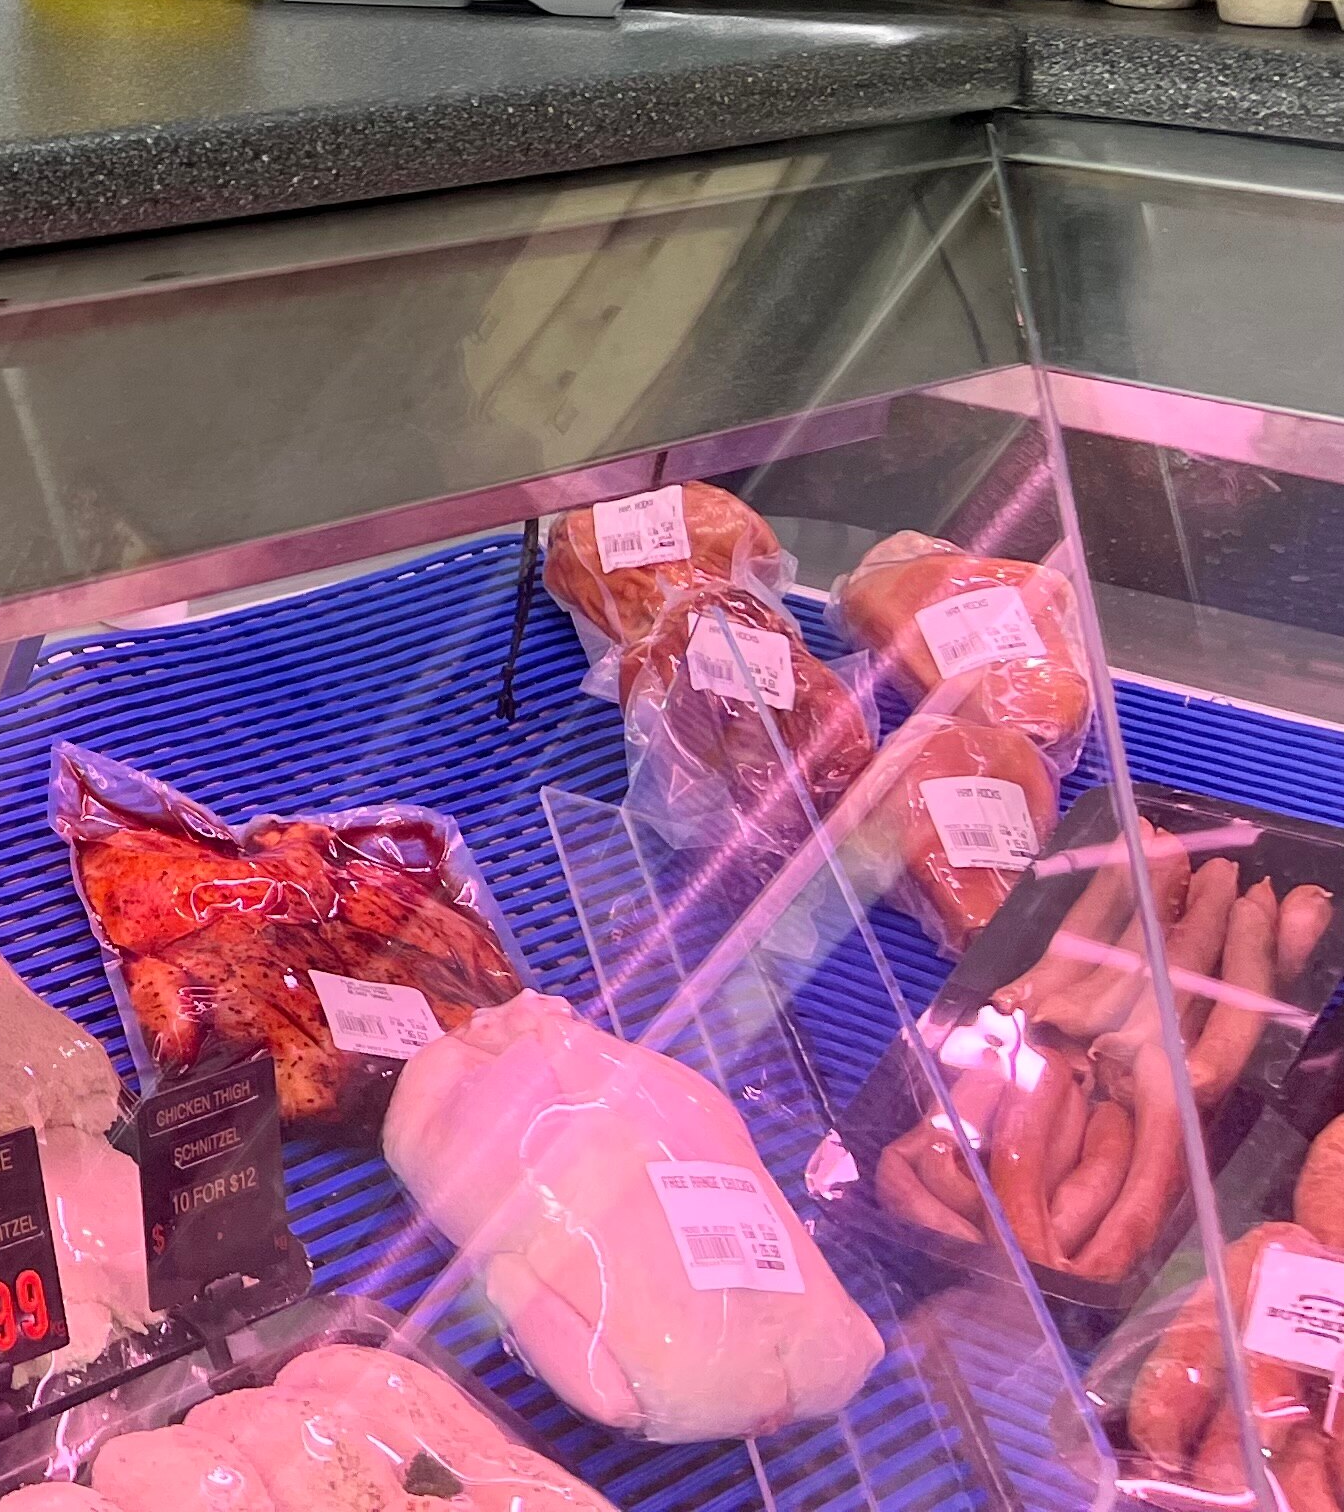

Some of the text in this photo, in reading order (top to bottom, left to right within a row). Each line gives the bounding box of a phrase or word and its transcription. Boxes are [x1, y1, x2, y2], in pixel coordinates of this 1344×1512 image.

[156, 1080, 251, 1128] CHICKEN THIGH
[174, 1127, 241, 1164] SCHNITZEL
[173, 1166, 257, 1215] 10 FOR $12
